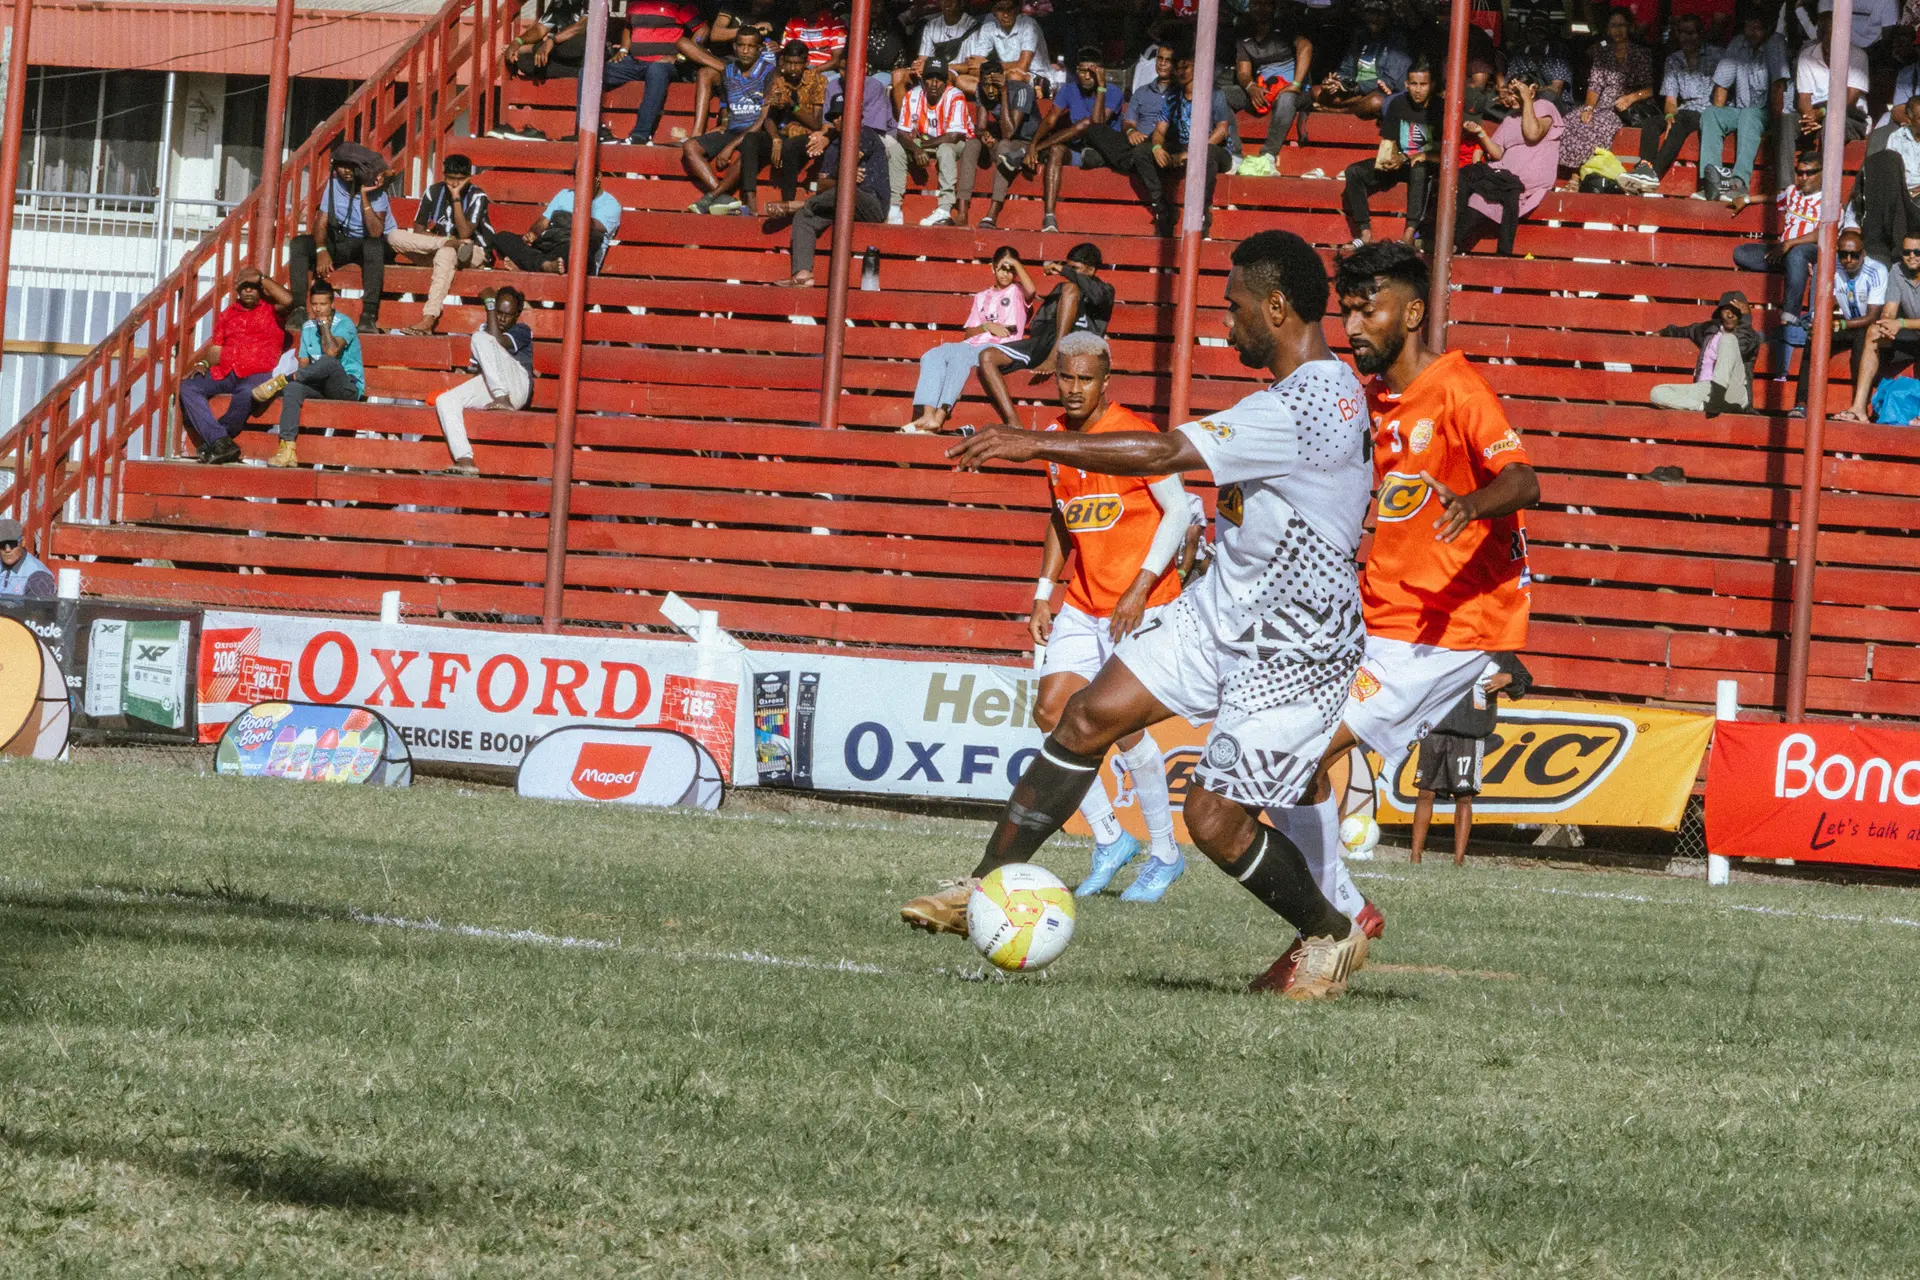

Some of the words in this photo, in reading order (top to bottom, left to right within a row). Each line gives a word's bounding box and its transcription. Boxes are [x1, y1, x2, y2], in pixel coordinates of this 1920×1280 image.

[298, 630, 652, 720] OXFORD
[238, 714, 272, 731] Boon
[239, 729, 273, 746] Boon
[1457, 756, 1472, 776] 17
[579, 768, 635, 785] Maped
[1811, 812, 1859, 850] Let's
[1868, 820, 1899, 840] talk
